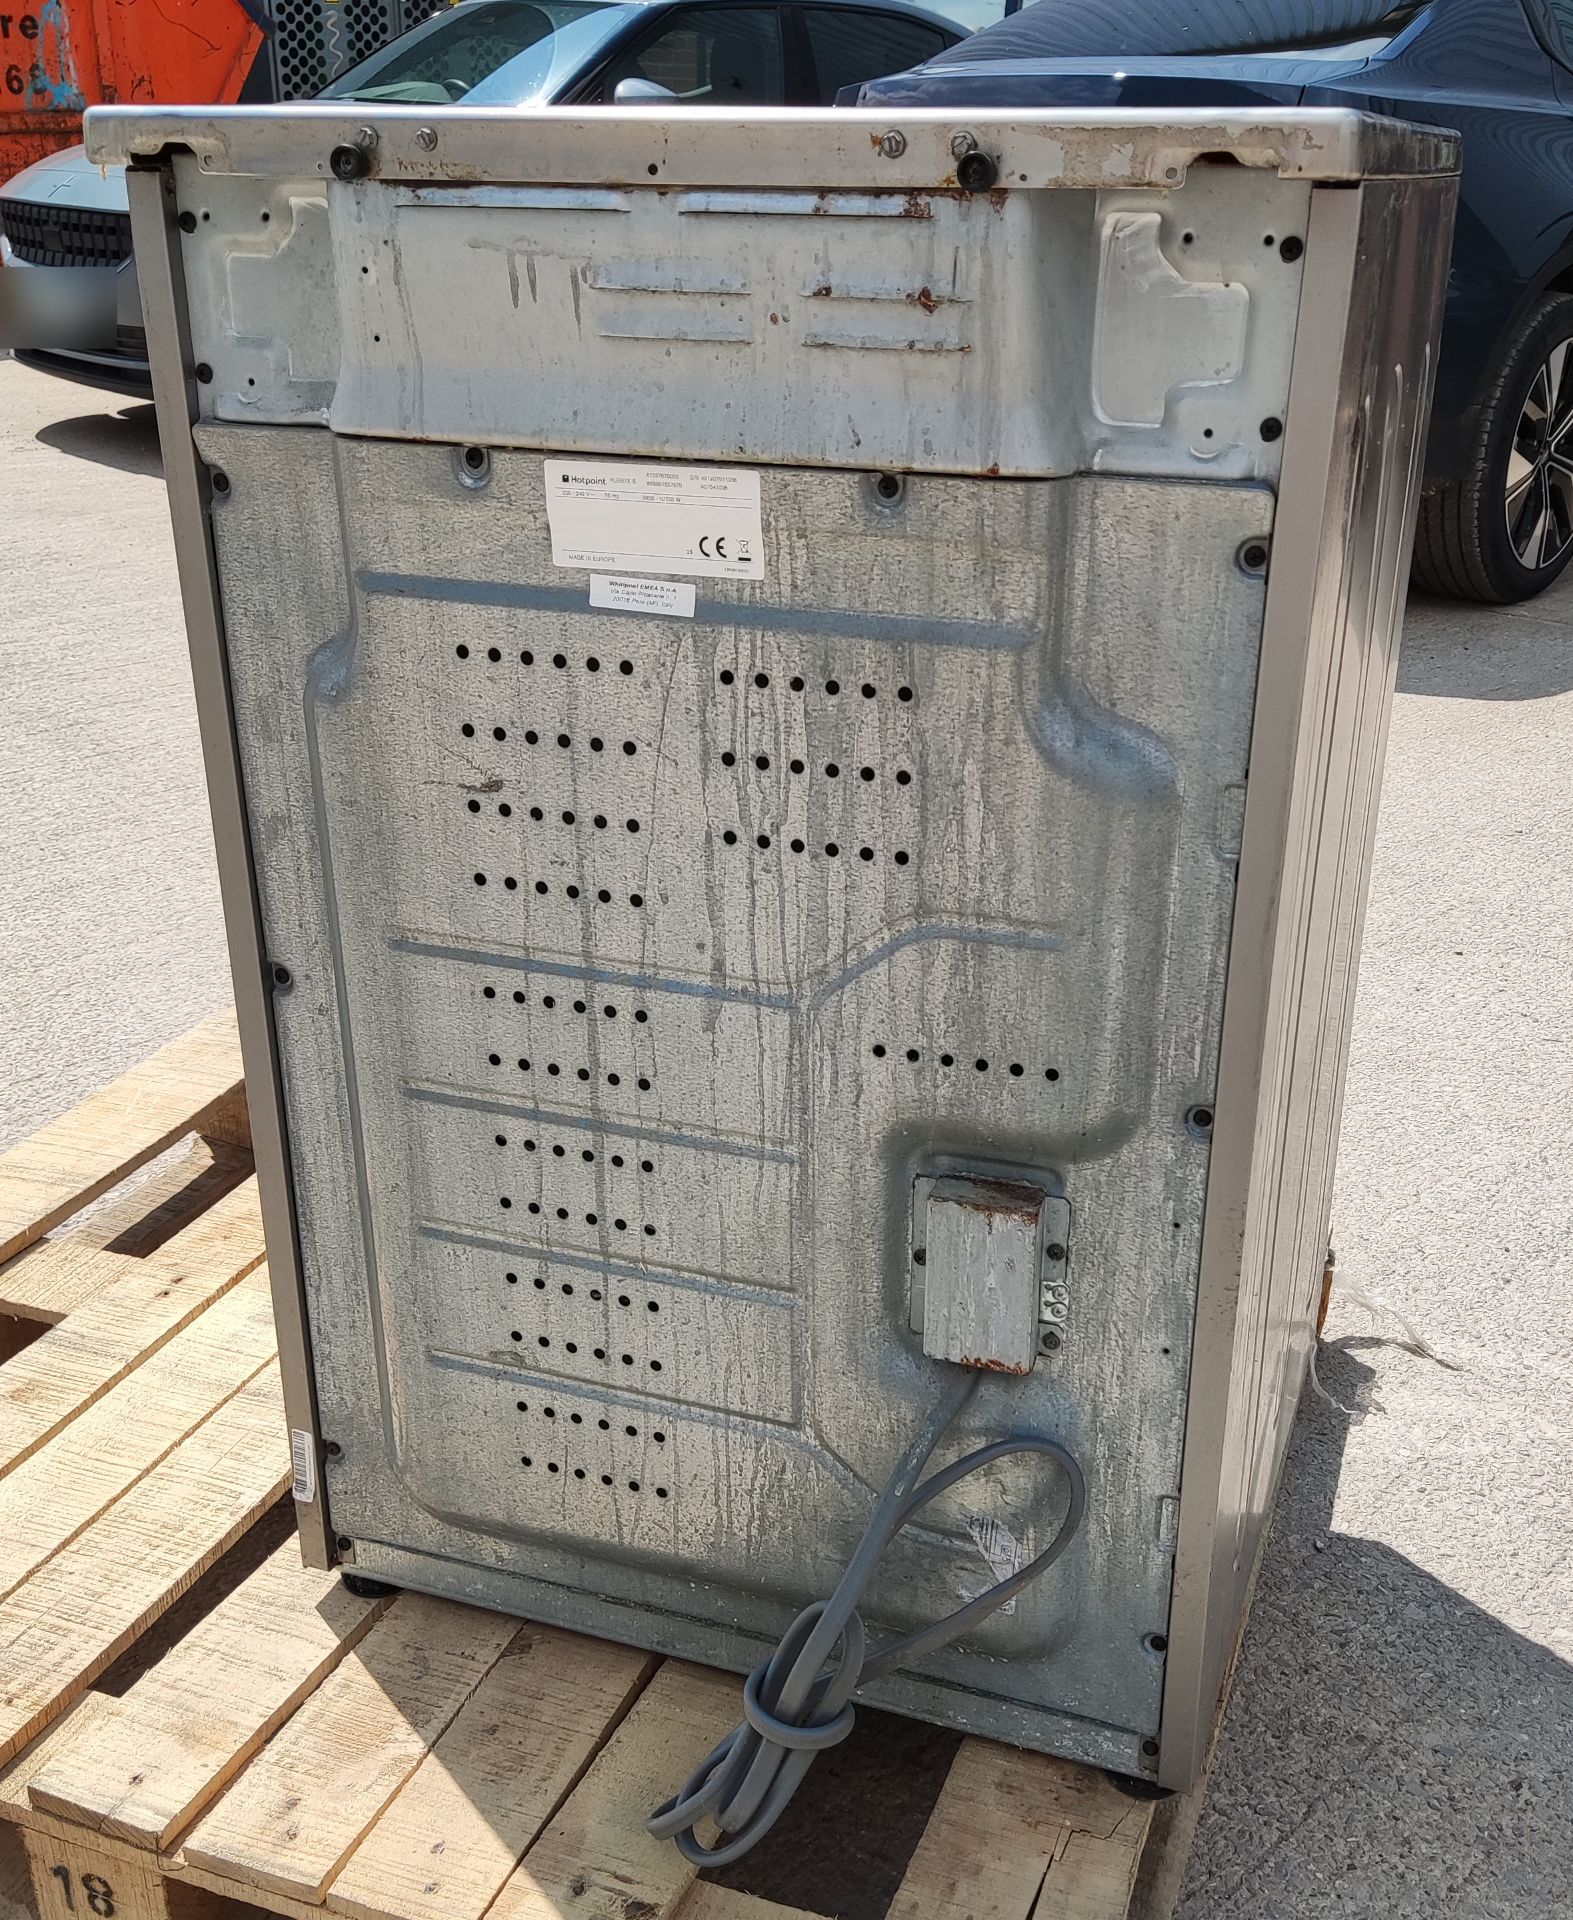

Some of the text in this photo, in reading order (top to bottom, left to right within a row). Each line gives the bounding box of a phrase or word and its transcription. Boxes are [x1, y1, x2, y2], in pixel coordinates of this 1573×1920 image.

[571, 475, 606, 485] Hotpoint
[568, 553, 585, 561] MADE
[592, 555, 616, 563] EUROPE
[608, 580, 639, 590] Whirlpool
[640, 583, 659, 591] EMEA
[50, 1865, 115, 1918] 18
